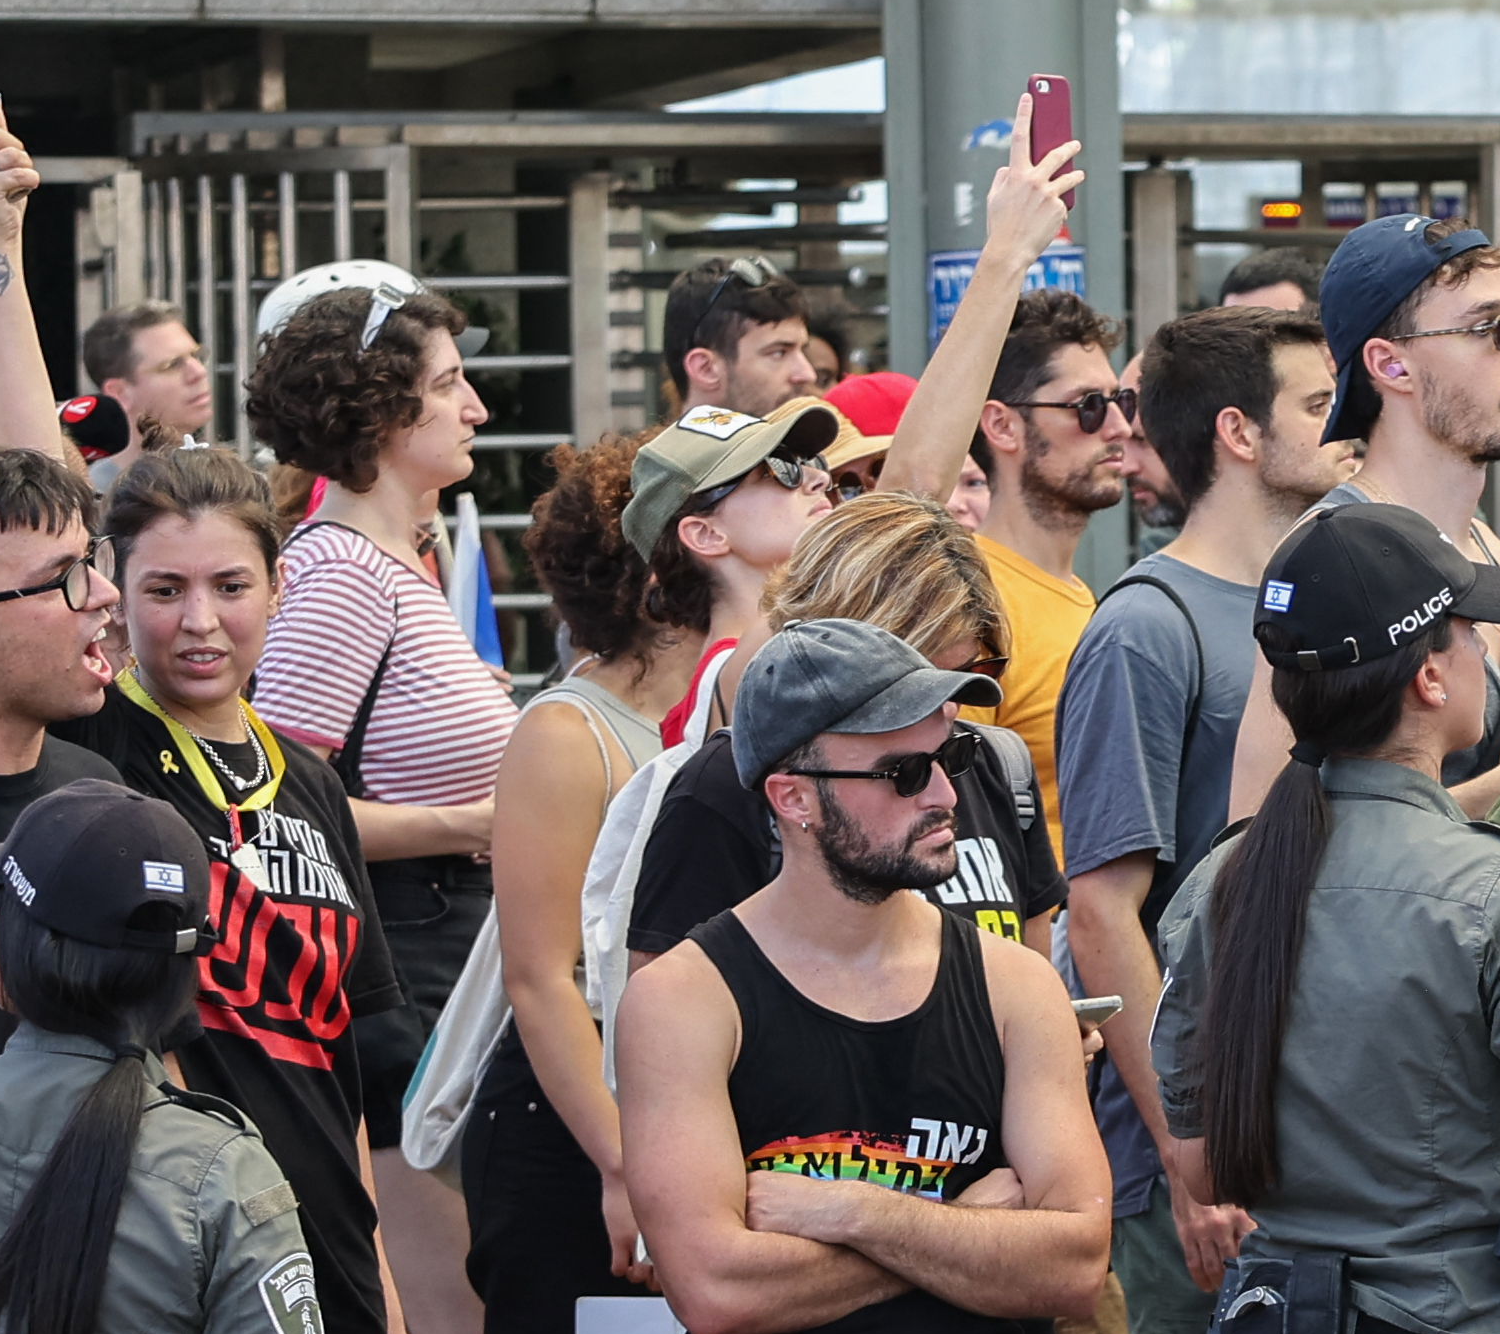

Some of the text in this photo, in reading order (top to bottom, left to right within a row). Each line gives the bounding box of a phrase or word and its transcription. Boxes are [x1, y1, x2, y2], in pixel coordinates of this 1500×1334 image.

[1387, 586, 1454, 646] POLICE
[256, 808, 337, 868] חזירים
[2, 854, 38, 908] משטרה
[905, 1116, 989, 1166] גאה
[269, 1264, 299, 1291] ישראל
